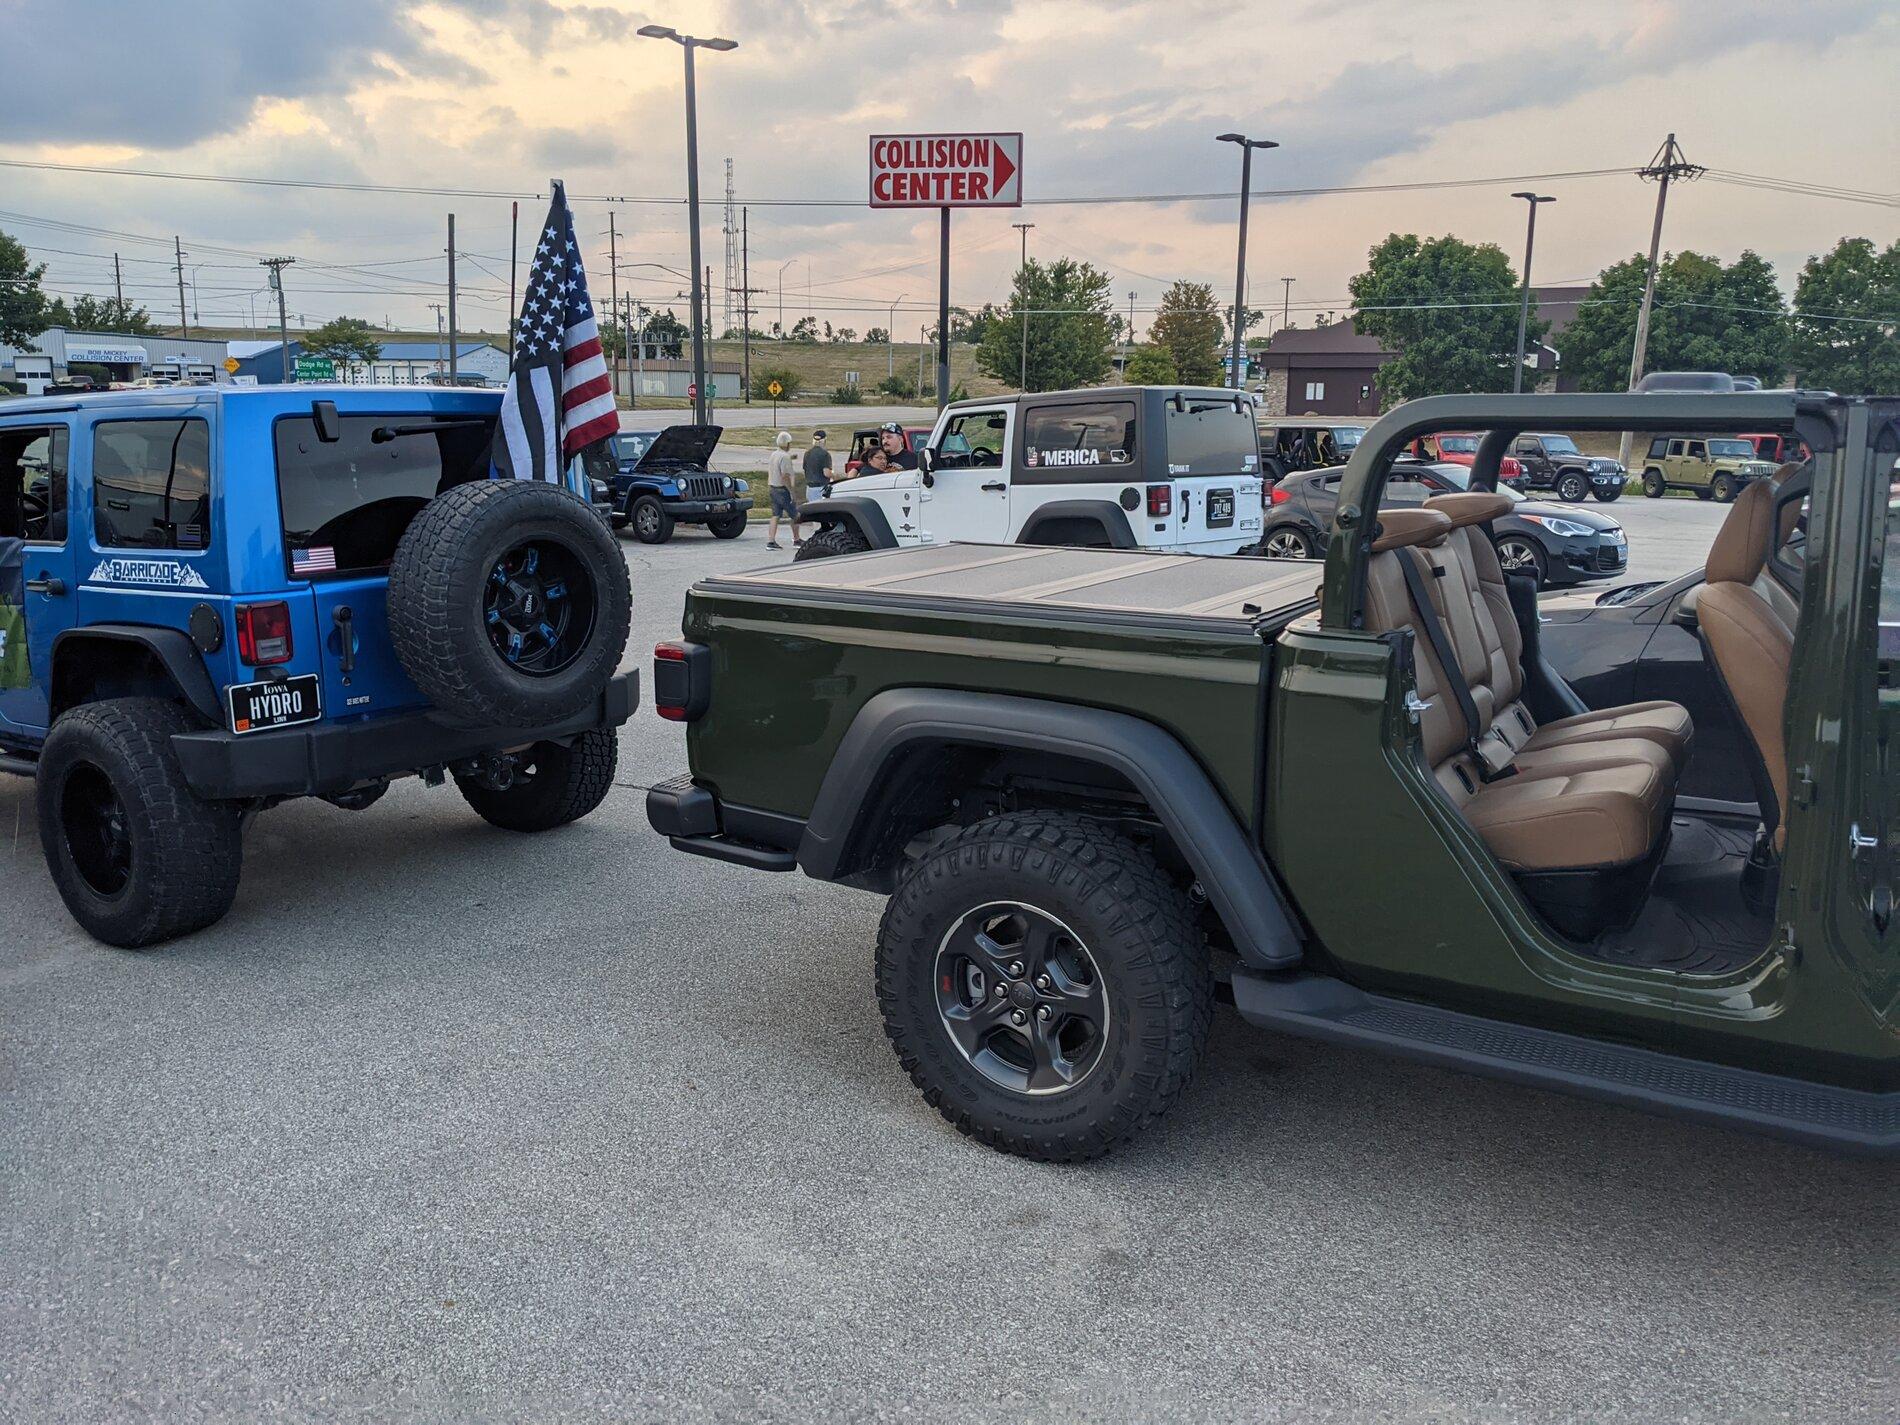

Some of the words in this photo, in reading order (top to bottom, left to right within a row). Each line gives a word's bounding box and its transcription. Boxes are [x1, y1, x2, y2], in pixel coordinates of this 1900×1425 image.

[874, 139, 989, 169] COLLISION
[874, 172, 989, 201] CENTER
[1041, 449, 1100, 466] 'MERICA
[112, 561, 179, 584] BARRICADE
[250, 690, 302, 720] HYDRO
